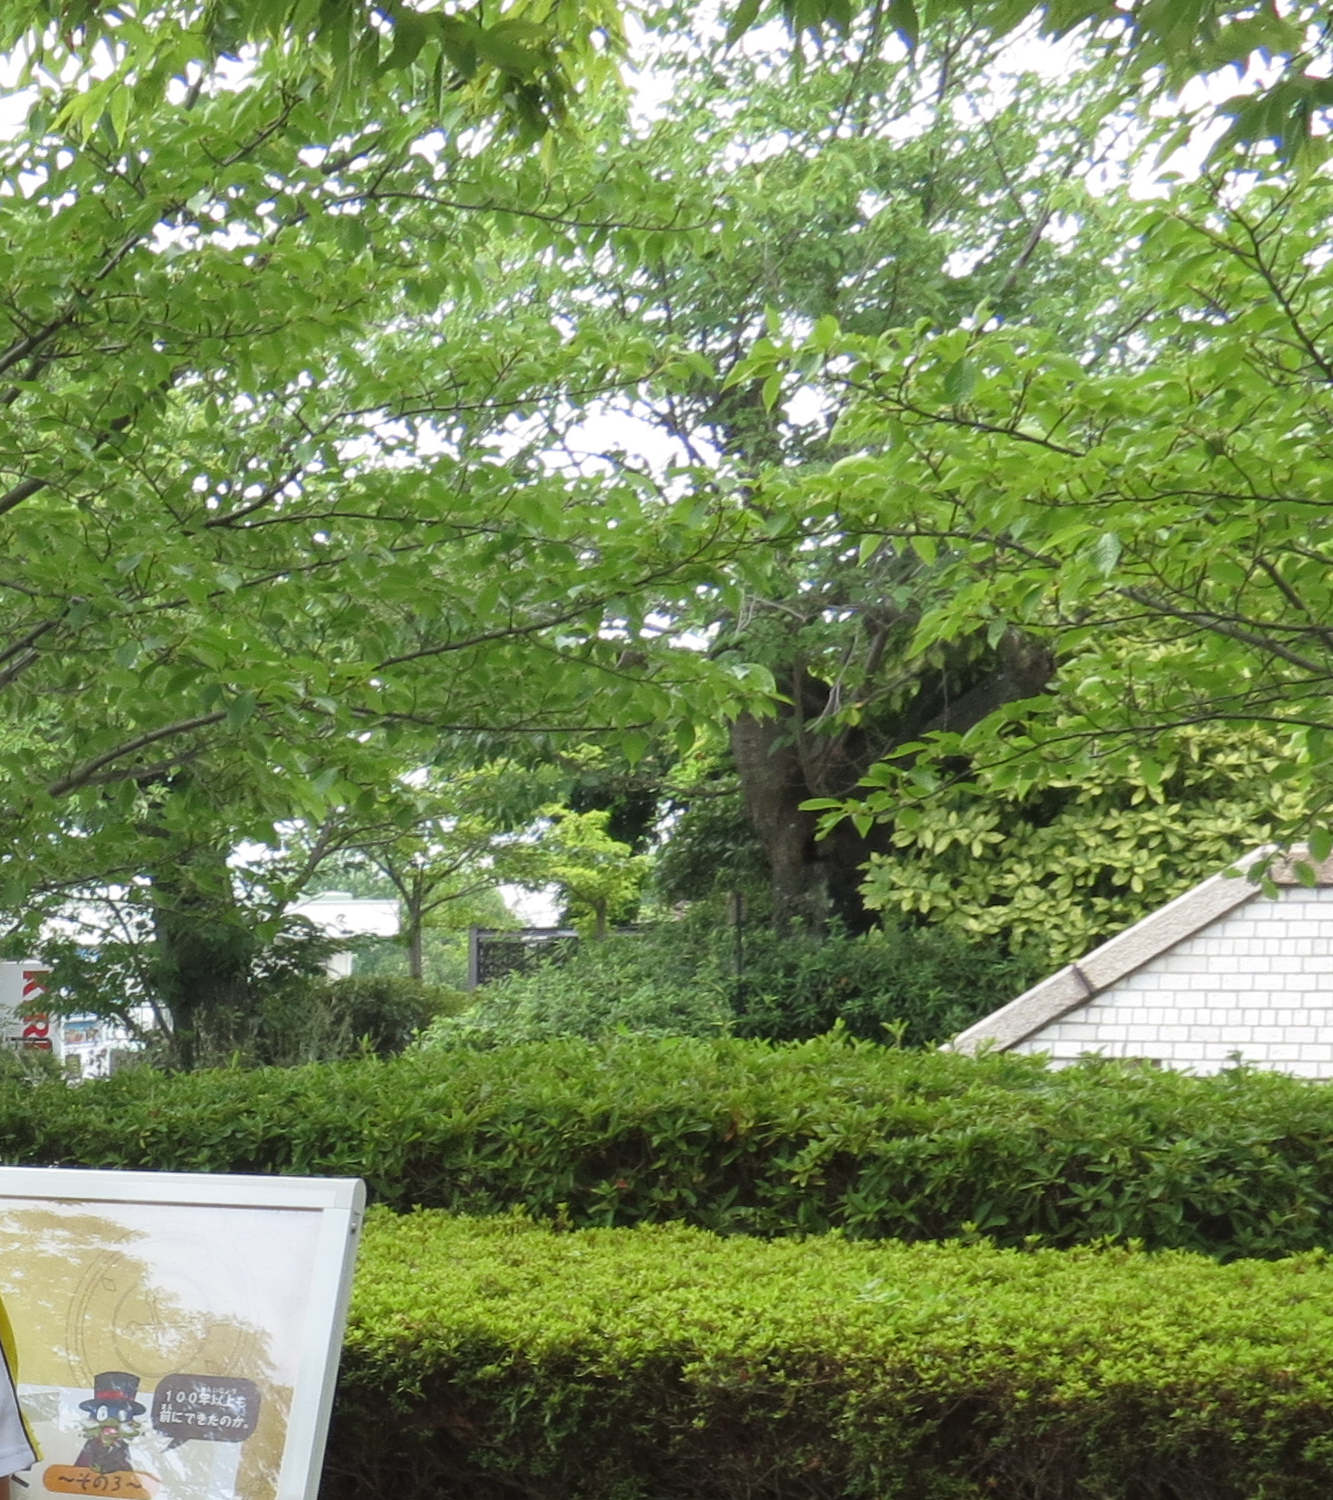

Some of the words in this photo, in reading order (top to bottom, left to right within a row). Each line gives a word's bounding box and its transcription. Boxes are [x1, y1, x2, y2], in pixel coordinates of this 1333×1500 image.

[159, 1410, 249, 1430] 前にできたのか。
